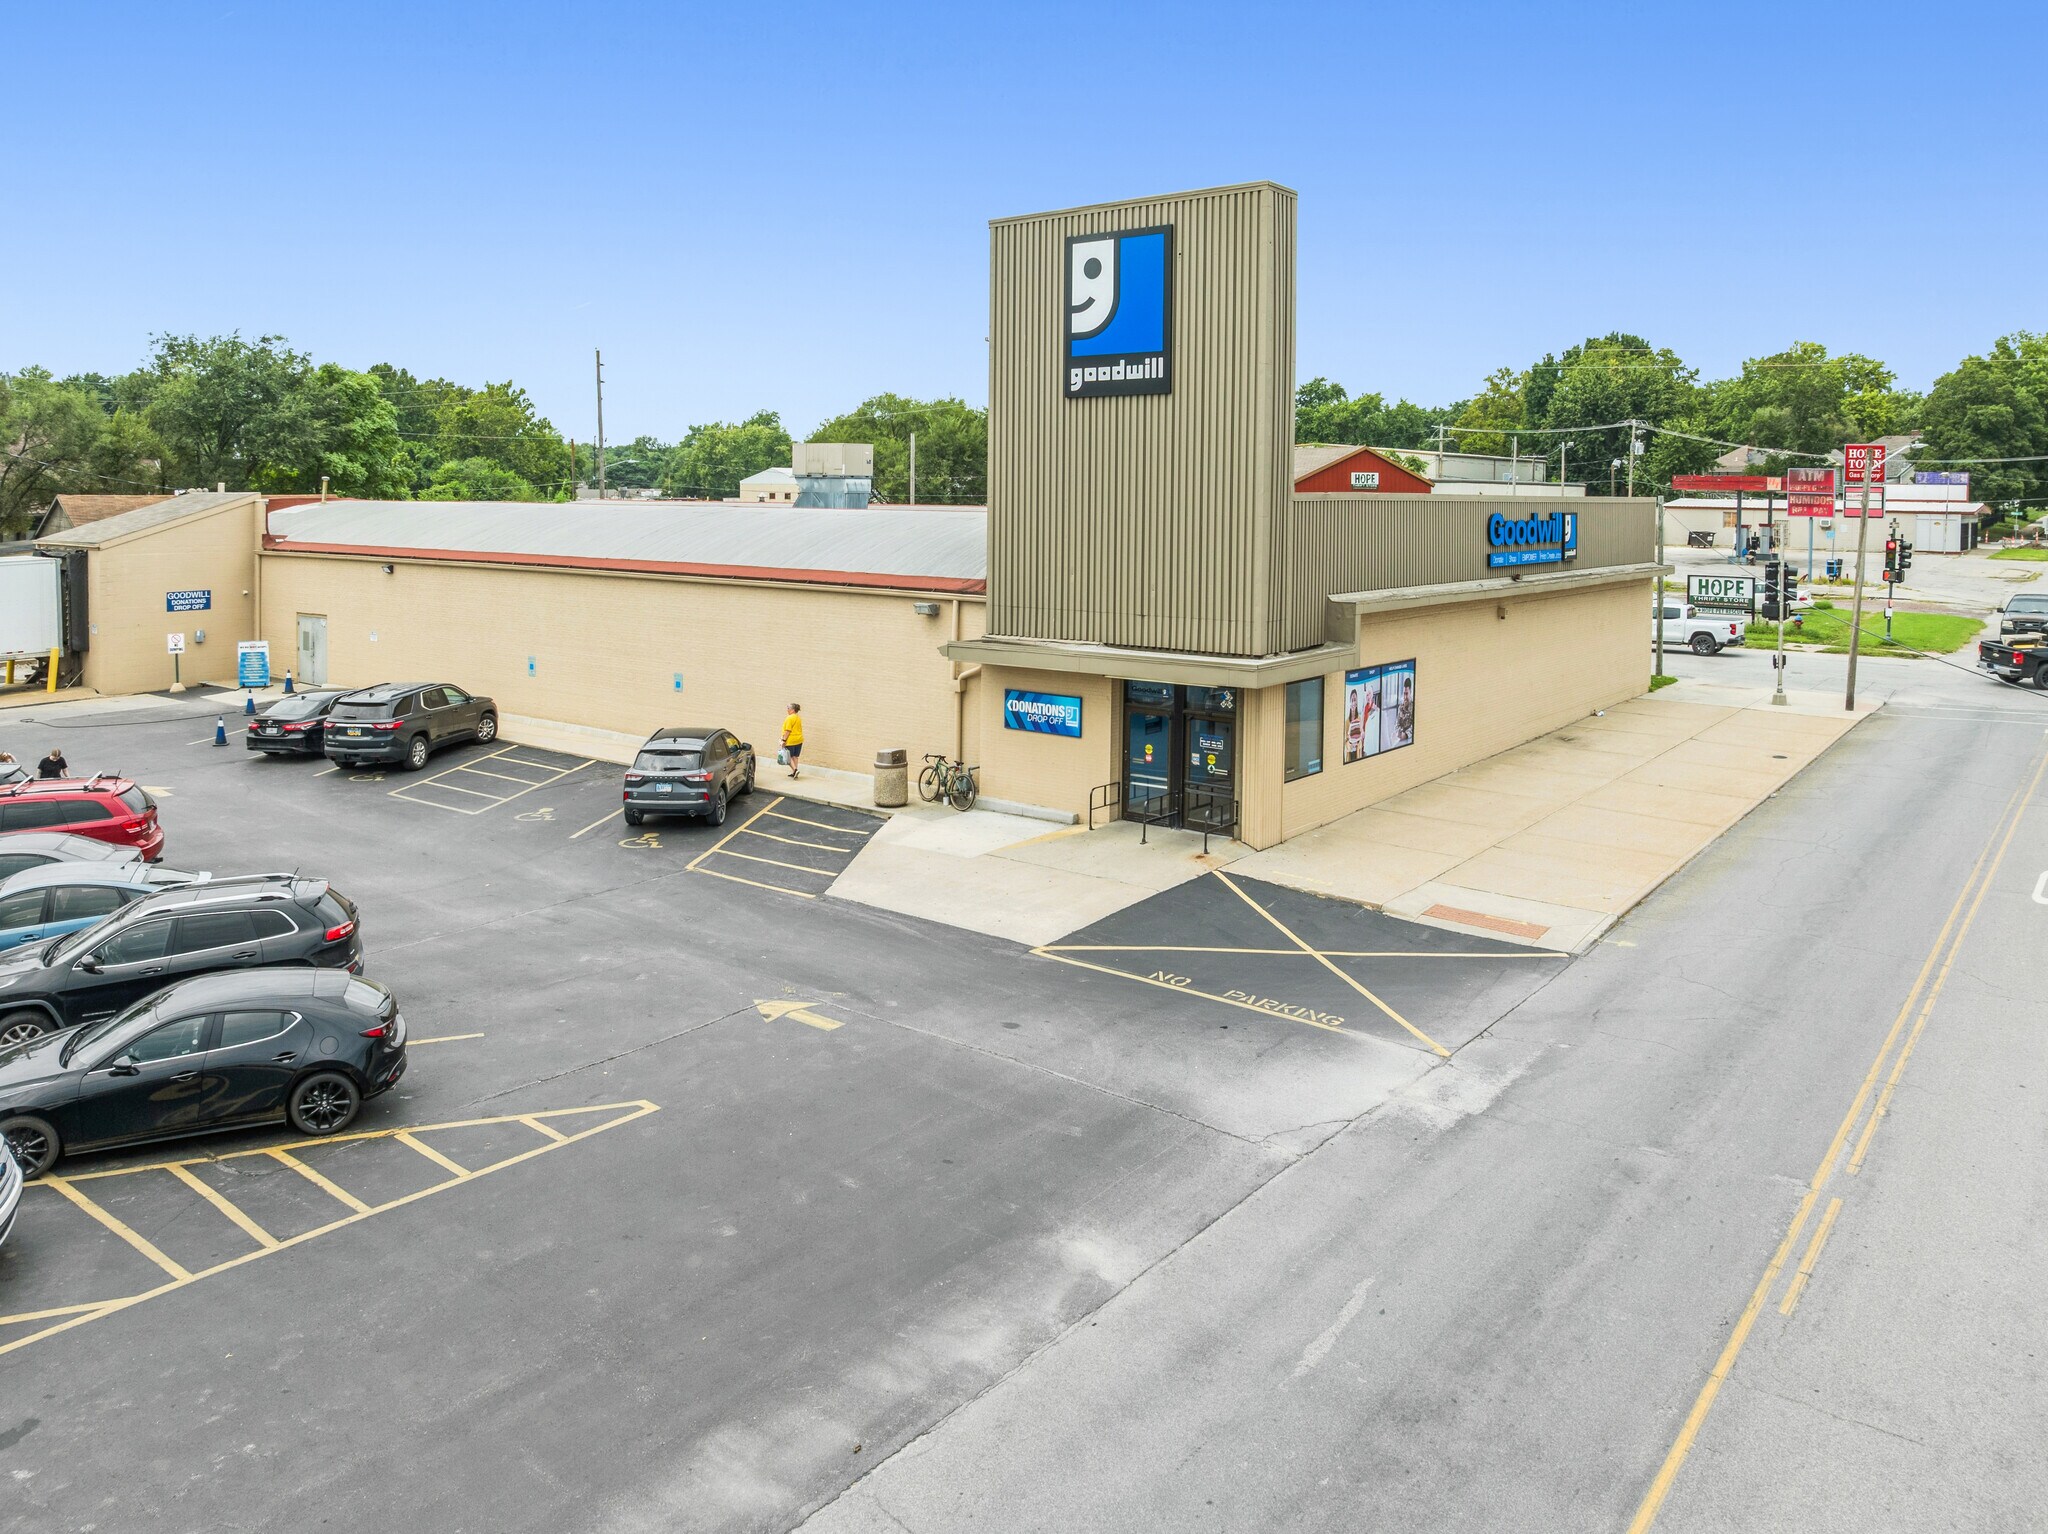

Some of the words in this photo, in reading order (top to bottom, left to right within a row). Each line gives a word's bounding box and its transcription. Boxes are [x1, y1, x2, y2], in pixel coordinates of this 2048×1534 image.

[1070, 357, 1164, 391] goodwill
[1848, 449, 1882, 458] HOE
[1354, 474, 1375, 483] HOPE
[1798, 470, 1825, 481] ATM
[1790, 494, 1833, 505] HUMIDOR
[1488, 512, 1563, 546] Goodwill
[1698, 578, 1744, 596] HOPE
[167, 591, 210, 600] GOODWILL
[1012, 700, 1066, 717] DONATIONS
[1027, 714, 1048, 723] DROP
[1049, 716, 1064, 725] OFF
[1148, 970, 1192, 987] NO
[1223, 989, 1345, 1026] PARKING
